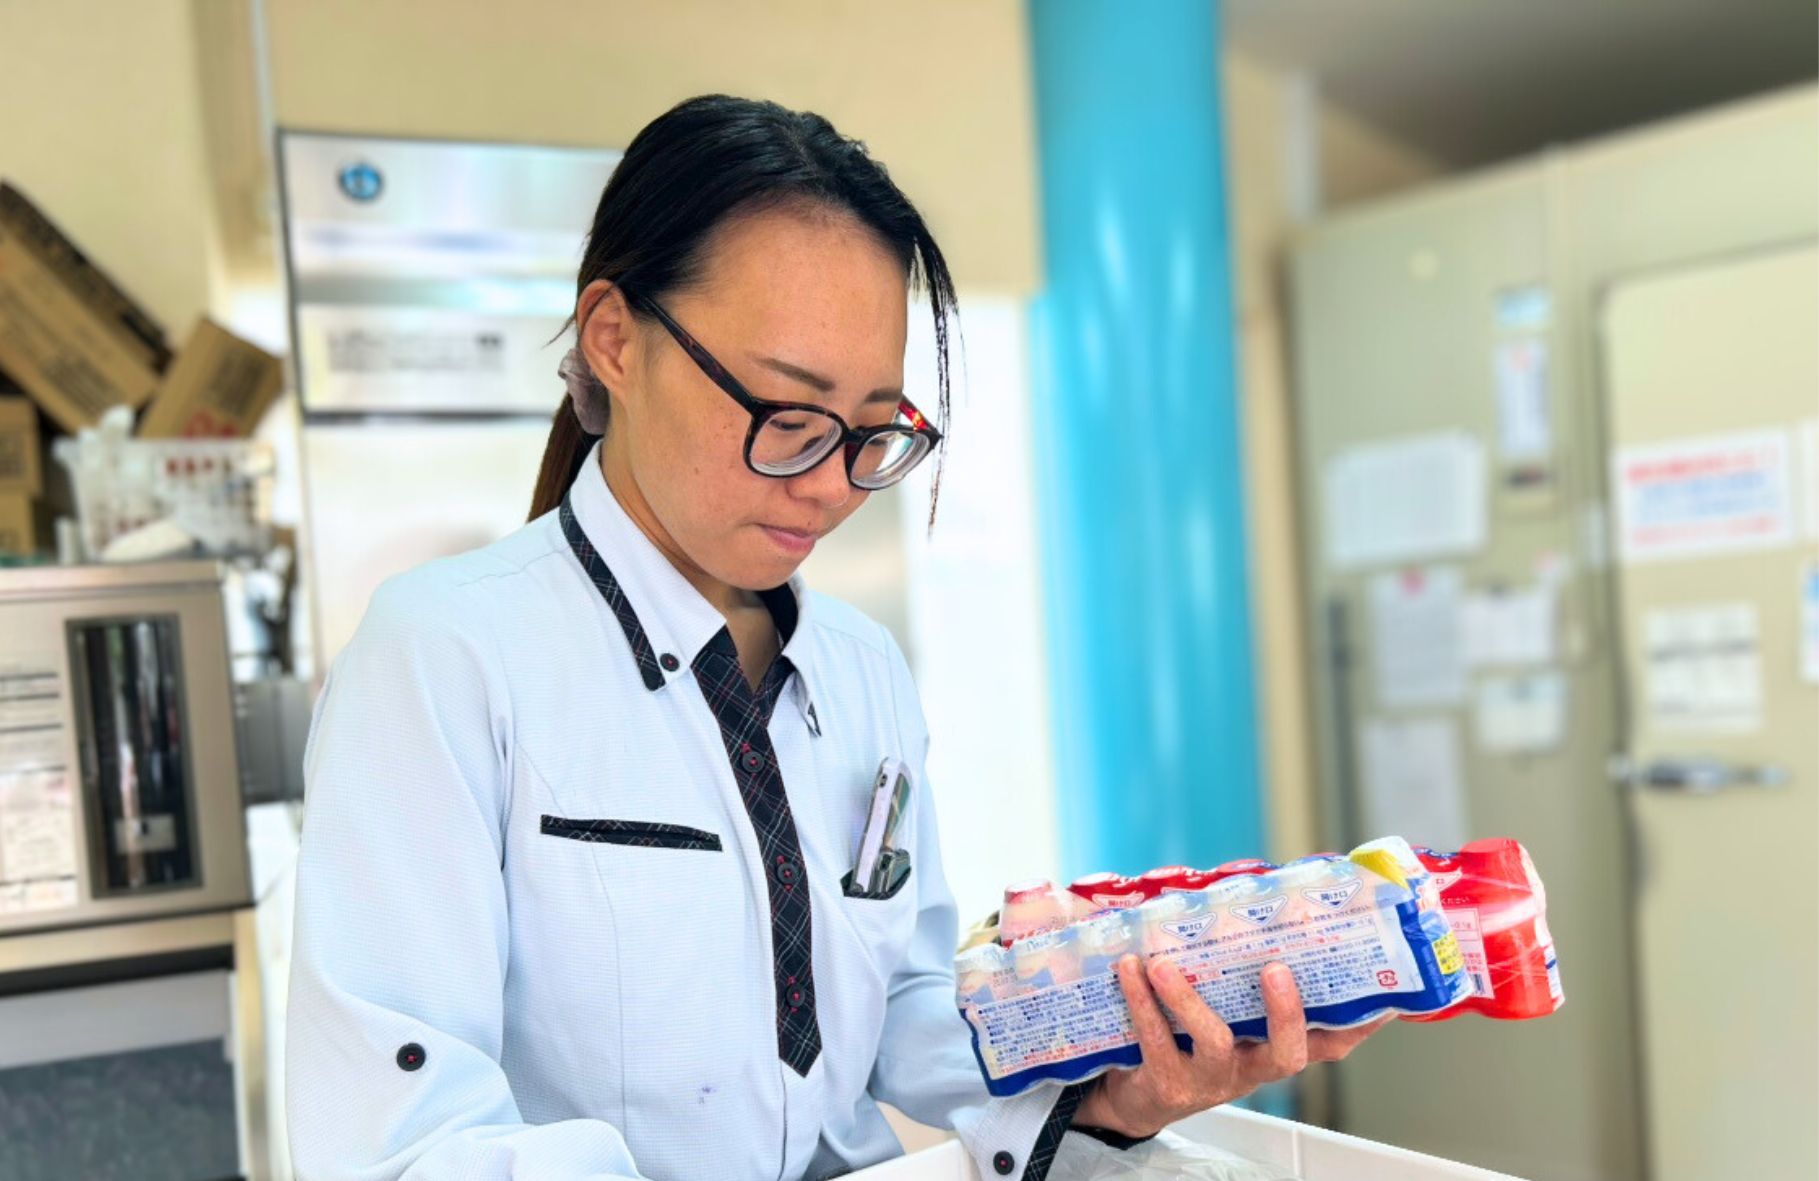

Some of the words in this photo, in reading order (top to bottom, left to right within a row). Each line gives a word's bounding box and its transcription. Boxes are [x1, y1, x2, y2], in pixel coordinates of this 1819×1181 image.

[1321, 890, 1348, 900] 開け口
[1248, 906, 1273, 918] 開け口
[1178, 922, 1203, 935] 開け口
